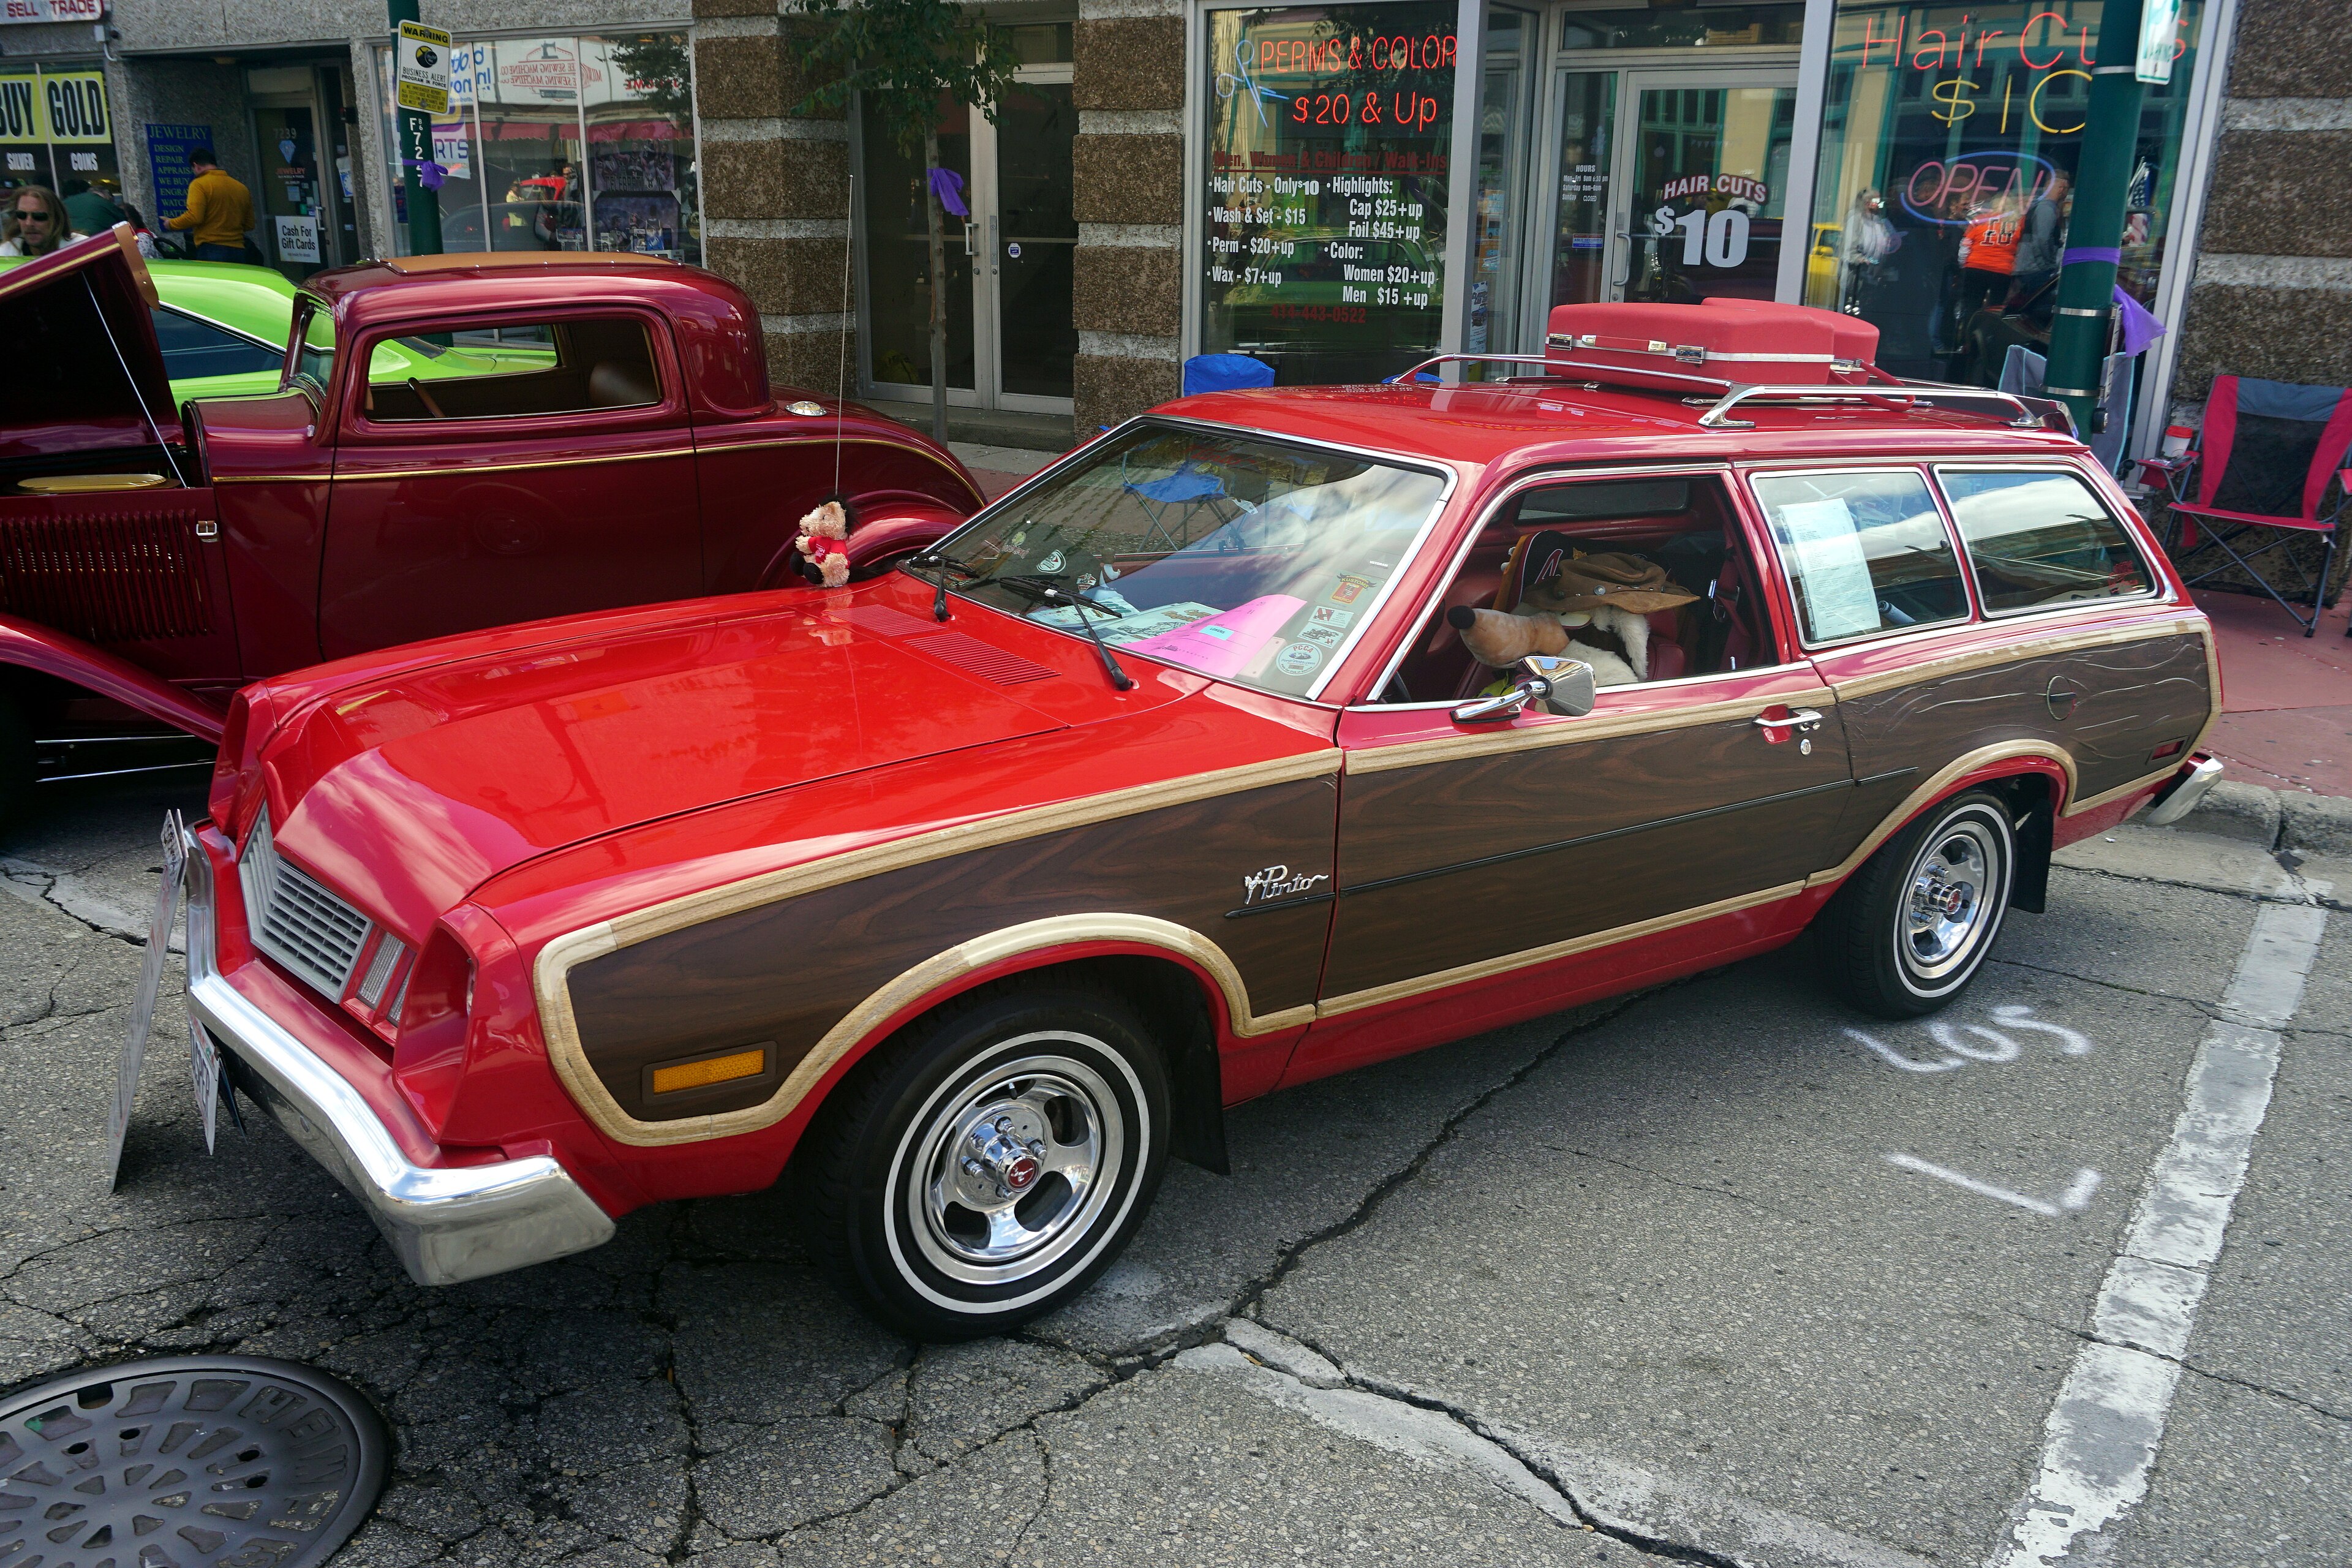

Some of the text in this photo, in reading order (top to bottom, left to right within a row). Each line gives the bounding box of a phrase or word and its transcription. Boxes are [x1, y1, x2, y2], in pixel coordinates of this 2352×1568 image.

[7, 0, 96, 17] SELL TRADE
[404, 26, 448, 43] WARNING
[1863, 15, 2003, 70] Hair
[1261, 35, 1458, 72] PERMS & COLOR
[402, 66, 446, 83] BUSINESS ALERT
[402, 74, 424, 83] PROGRAM
[47, 78, 105, 137] GOLD
[1293, 91, 1438, 132] $20 & Up
[150, 126, 207, 140] JEWELRY
[7, 153, 99, 172] SILVER COINS
[1314, 151, 1372, 169] Children
[1384, 151, 1447, 170] Walk-Ins
[1213, 176, 1236, 194] Hair
[1238, 176, 1263, 194] Cuts
[1333, 176, 1393, 197] Highlights:
[1663, 174, 1767, 204] HAIR CUTS
[1213, 207, 1241, 224] Wash
[1245, 208, 1253, 224] &
[1256, 208, 1273, 224] Set
[1284, 208, 1306, 225] $15
[1349, 198, 1422, 221] Cap $25+up
[282, 225, 312, 237] Cash For
[1349, 221, 1420, 243] Foil $45+up
[1654, 206, 1750, 268] $10
[282, 238, 316, 251] Gift Cards
[1212, 236, 1238, 253] Perm
[1250, 236, 1294, 258] $20+up
[1330, 242, 1363, 260] Color:
[1212, 266, 1234, 283] Wax
[1245, 268, 1282, 288] $7+up
[1343, 265, 1434, 288] Women $20+up
[1343, 286, 1366, 303] Men
[1377, 288, 1399, 306] $15
[1341, 578, 1369, 589] KUSTOMS
[1261, 864, 1329, 900] Pinto
